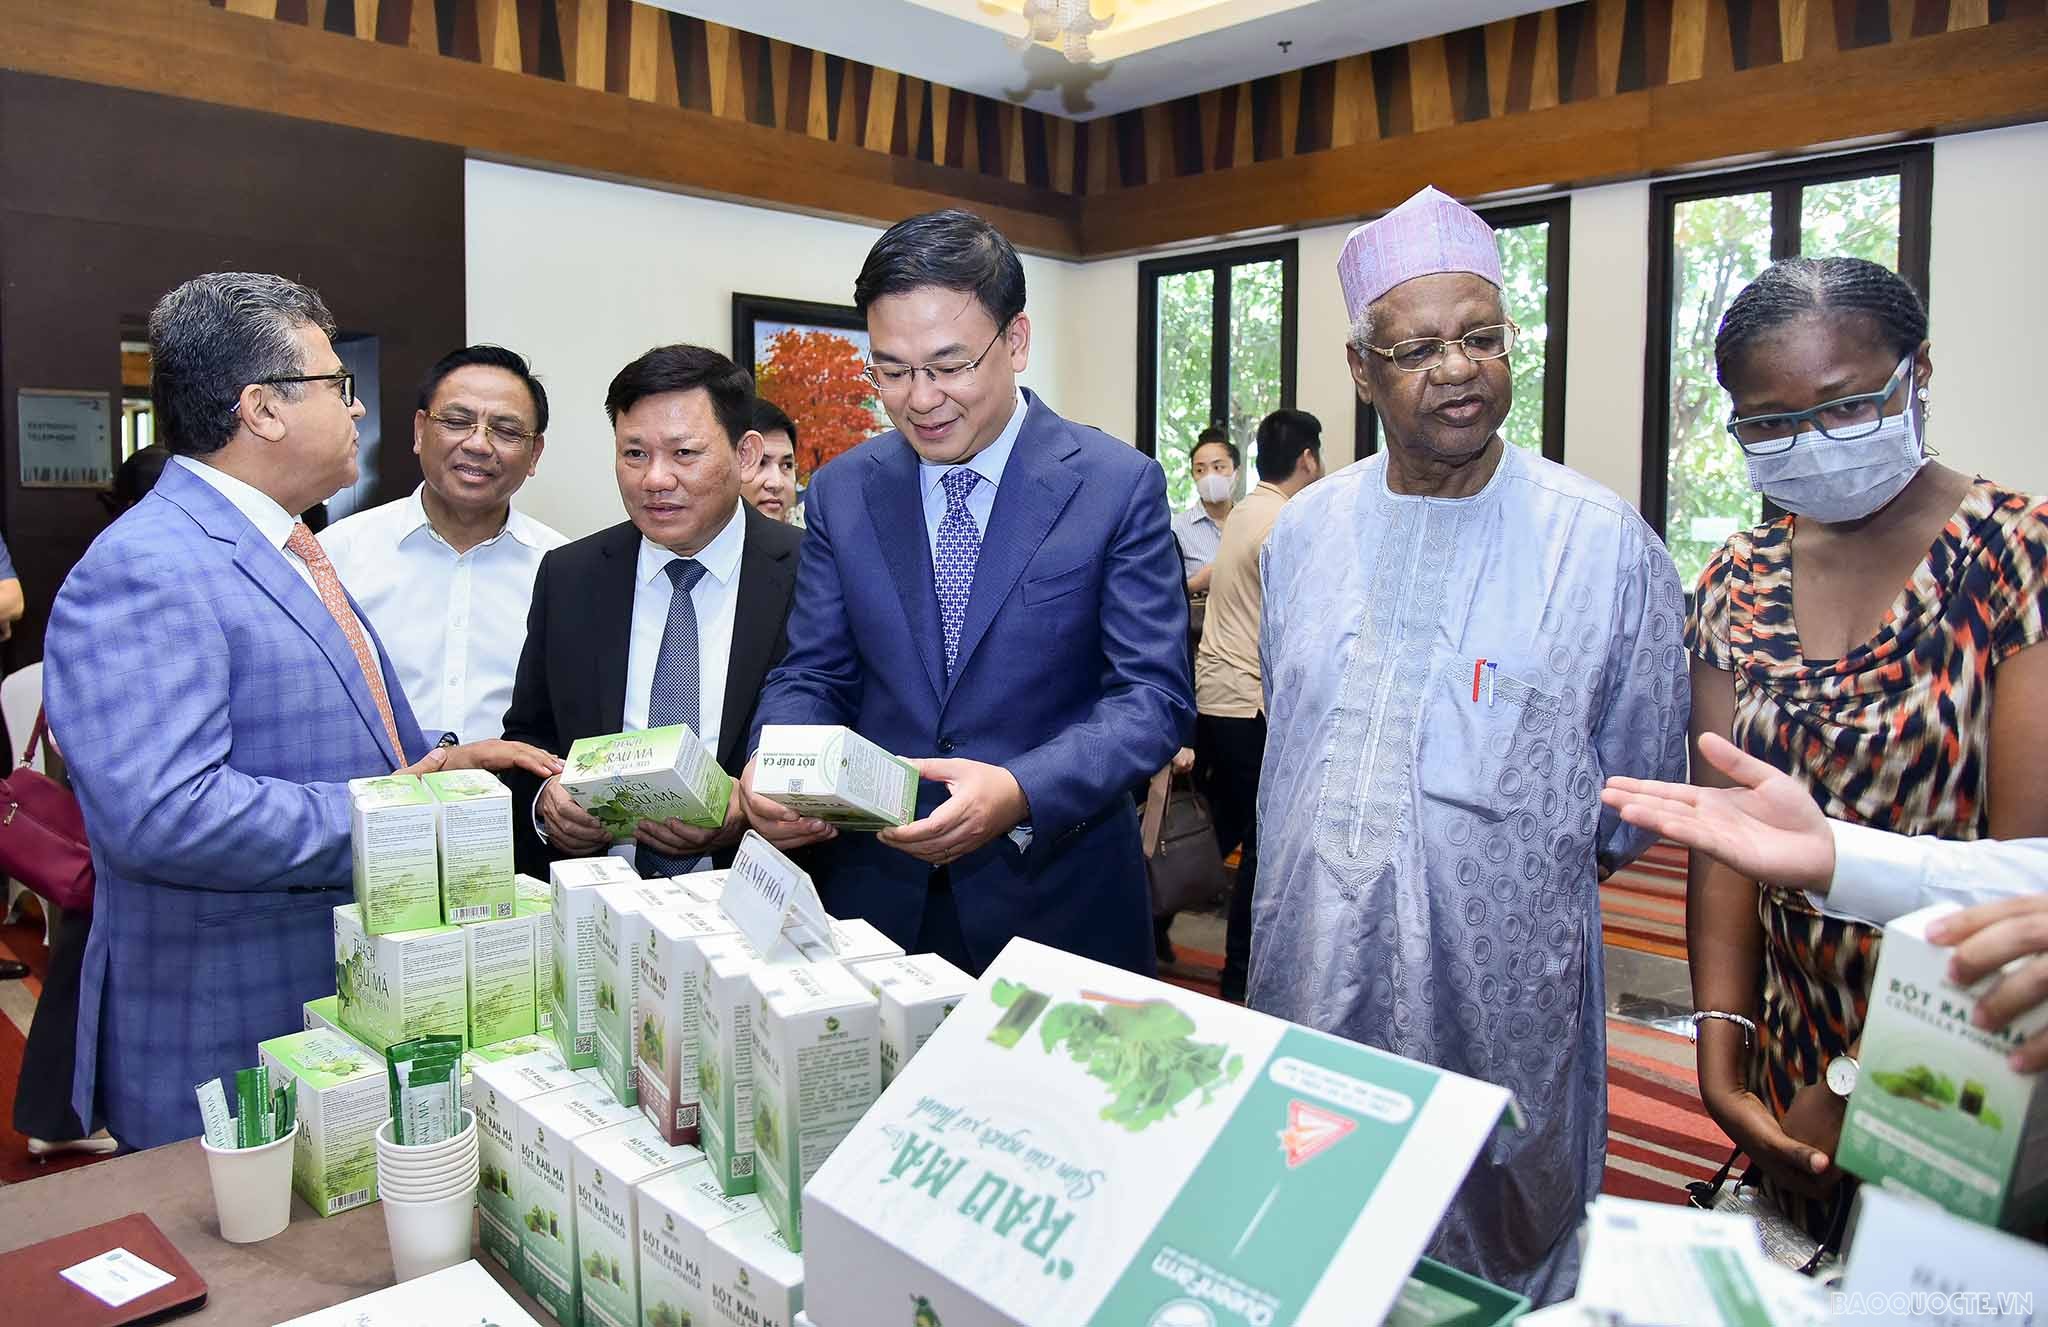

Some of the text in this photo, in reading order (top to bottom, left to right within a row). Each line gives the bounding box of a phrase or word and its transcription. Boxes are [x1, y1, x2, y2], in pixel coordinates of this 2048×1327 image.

[732, 849, 767, 892] THANH
[373, 972, 390, 998] MÁ
[488, 1116, 501, 1134] RAU
[536, 1154, 551, 1173] RAU
[879, 1131, 970, 1199] MÁ
[594, 1197, 609, 1217] RAU
[663, 1243, 682, 1266] RAU
[736, 1300, 759, 1325] RAU
